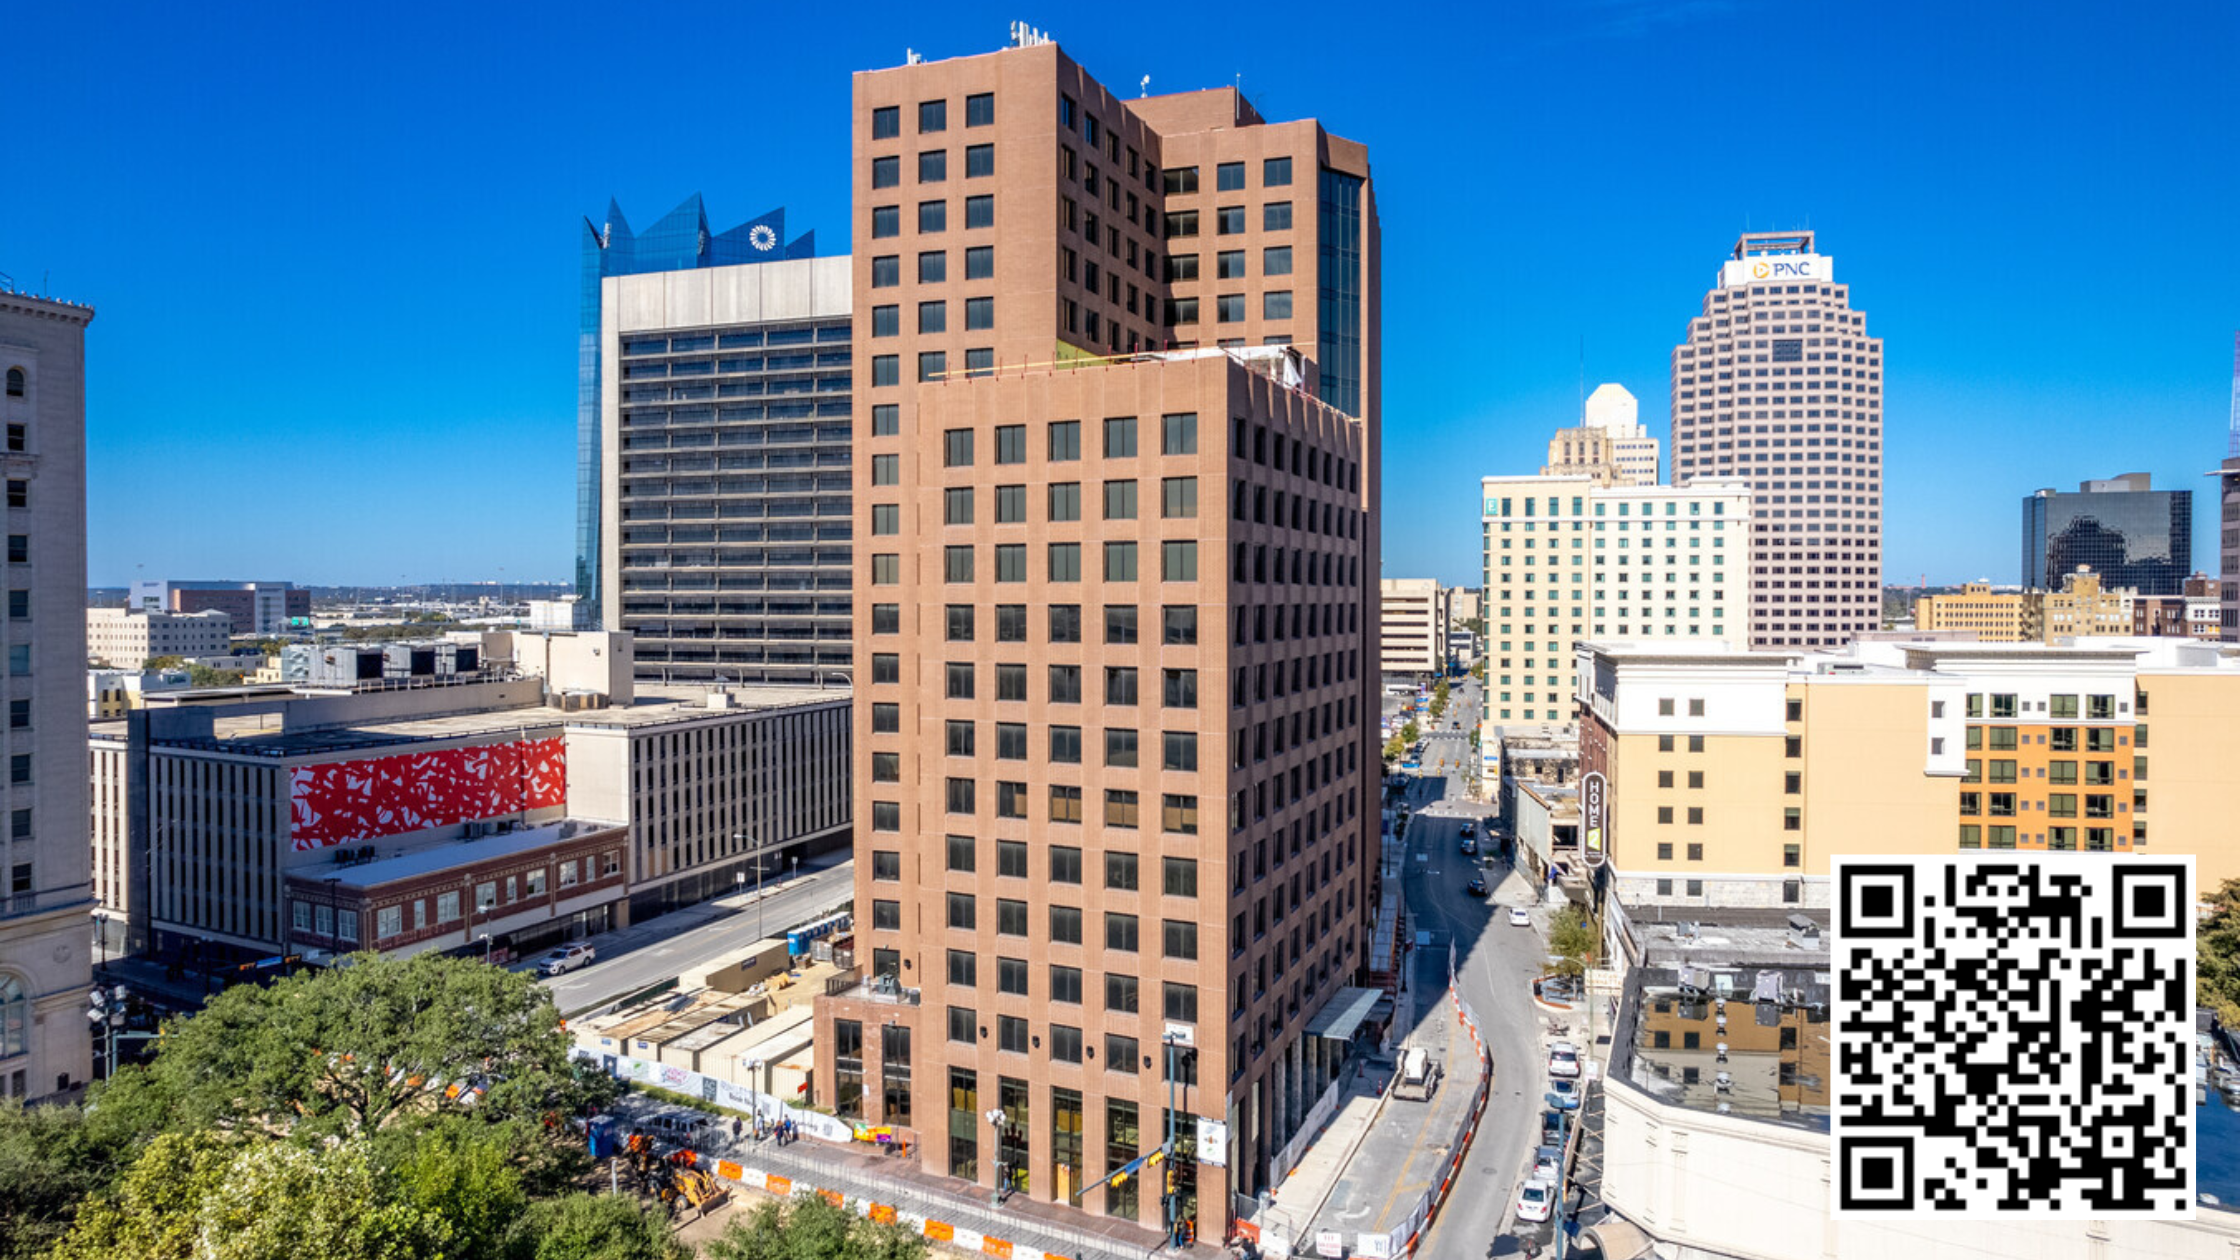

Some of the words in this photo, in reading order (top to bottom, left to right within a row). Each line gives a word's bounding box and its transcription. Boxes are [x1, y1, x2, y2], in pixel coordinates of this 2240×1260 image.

[1773, 262, 1810, 276] PNC
[1588, 781, 1600, 828] HOME
[1589, 831, 1599, 848] 2
